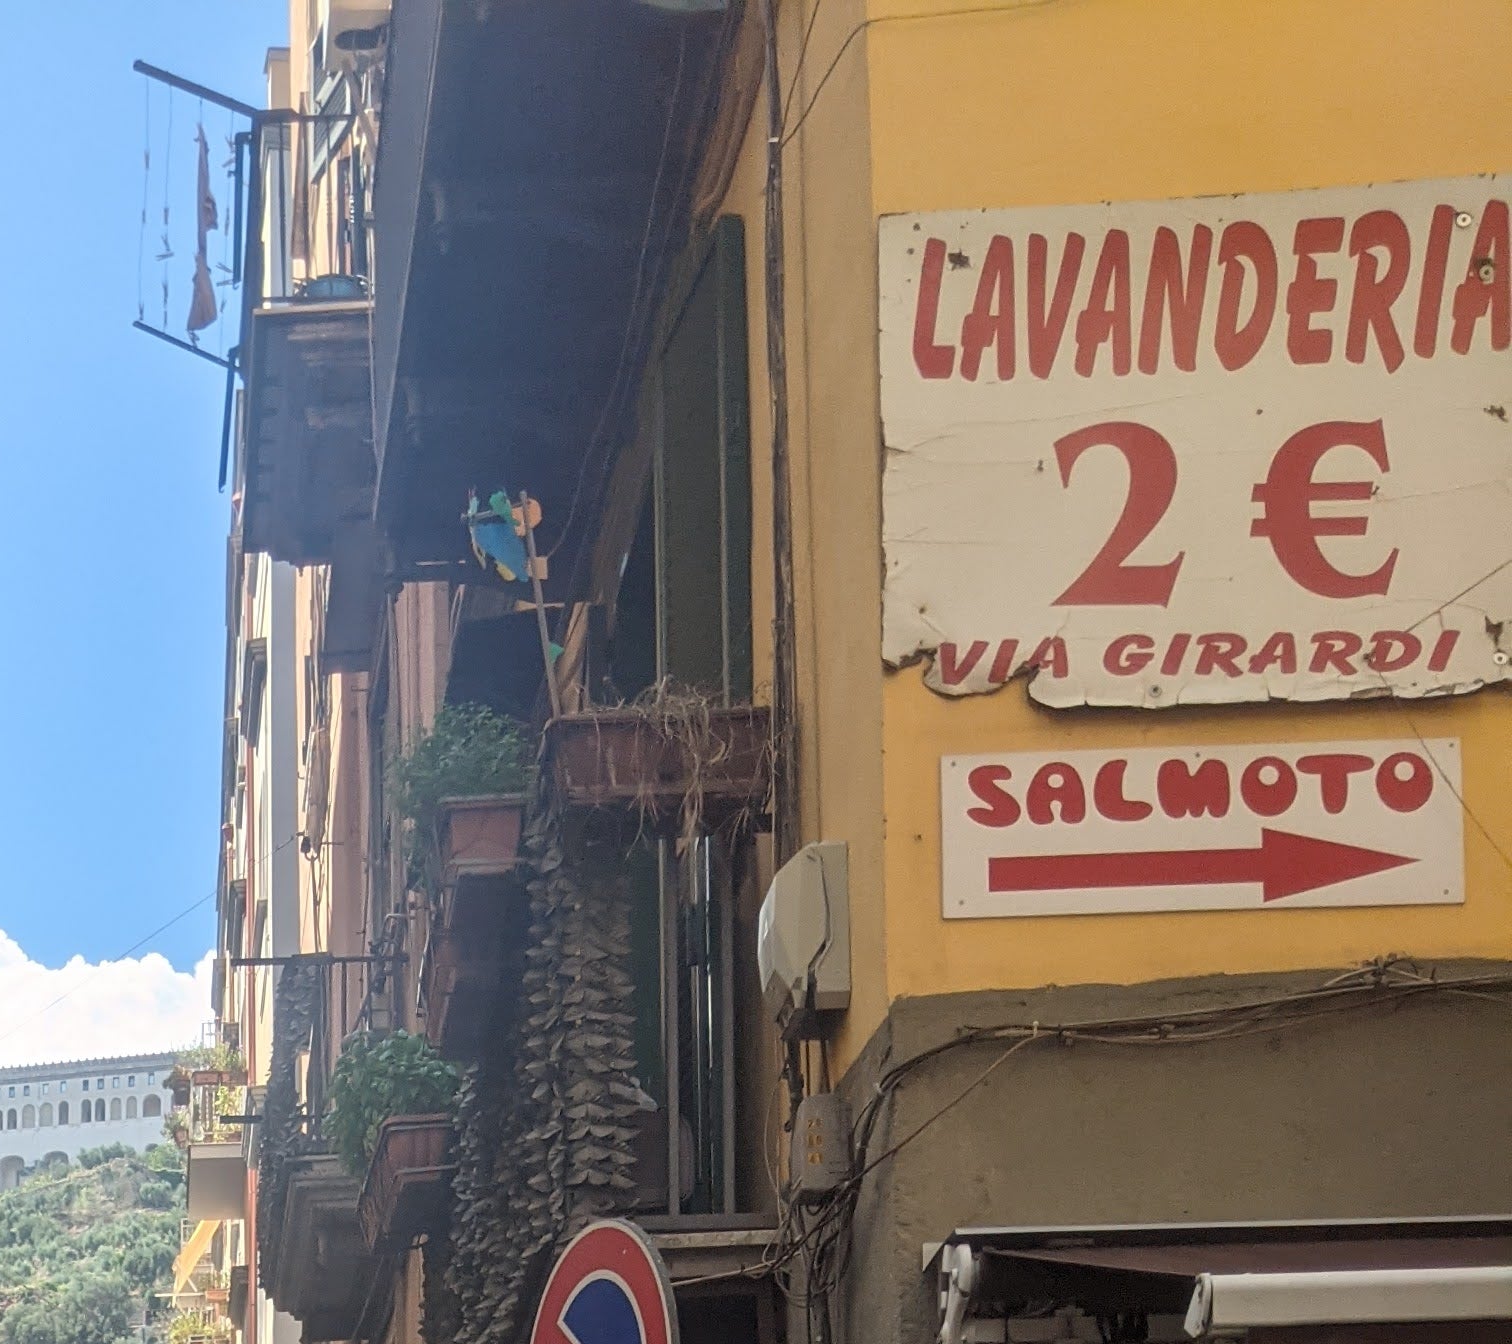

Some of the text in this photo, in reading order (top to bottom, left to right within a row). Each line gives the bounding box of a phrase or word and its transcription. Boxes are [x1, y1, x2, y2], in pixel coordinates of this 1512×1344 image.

[912, 198, 1512, 382] LAVANDERIA
[1050, 418, 1399, 609] 2 €
[937, 629, 1460, 687] VIA GIRARDI
[967, 751, 1433, 828] SALMOTO
